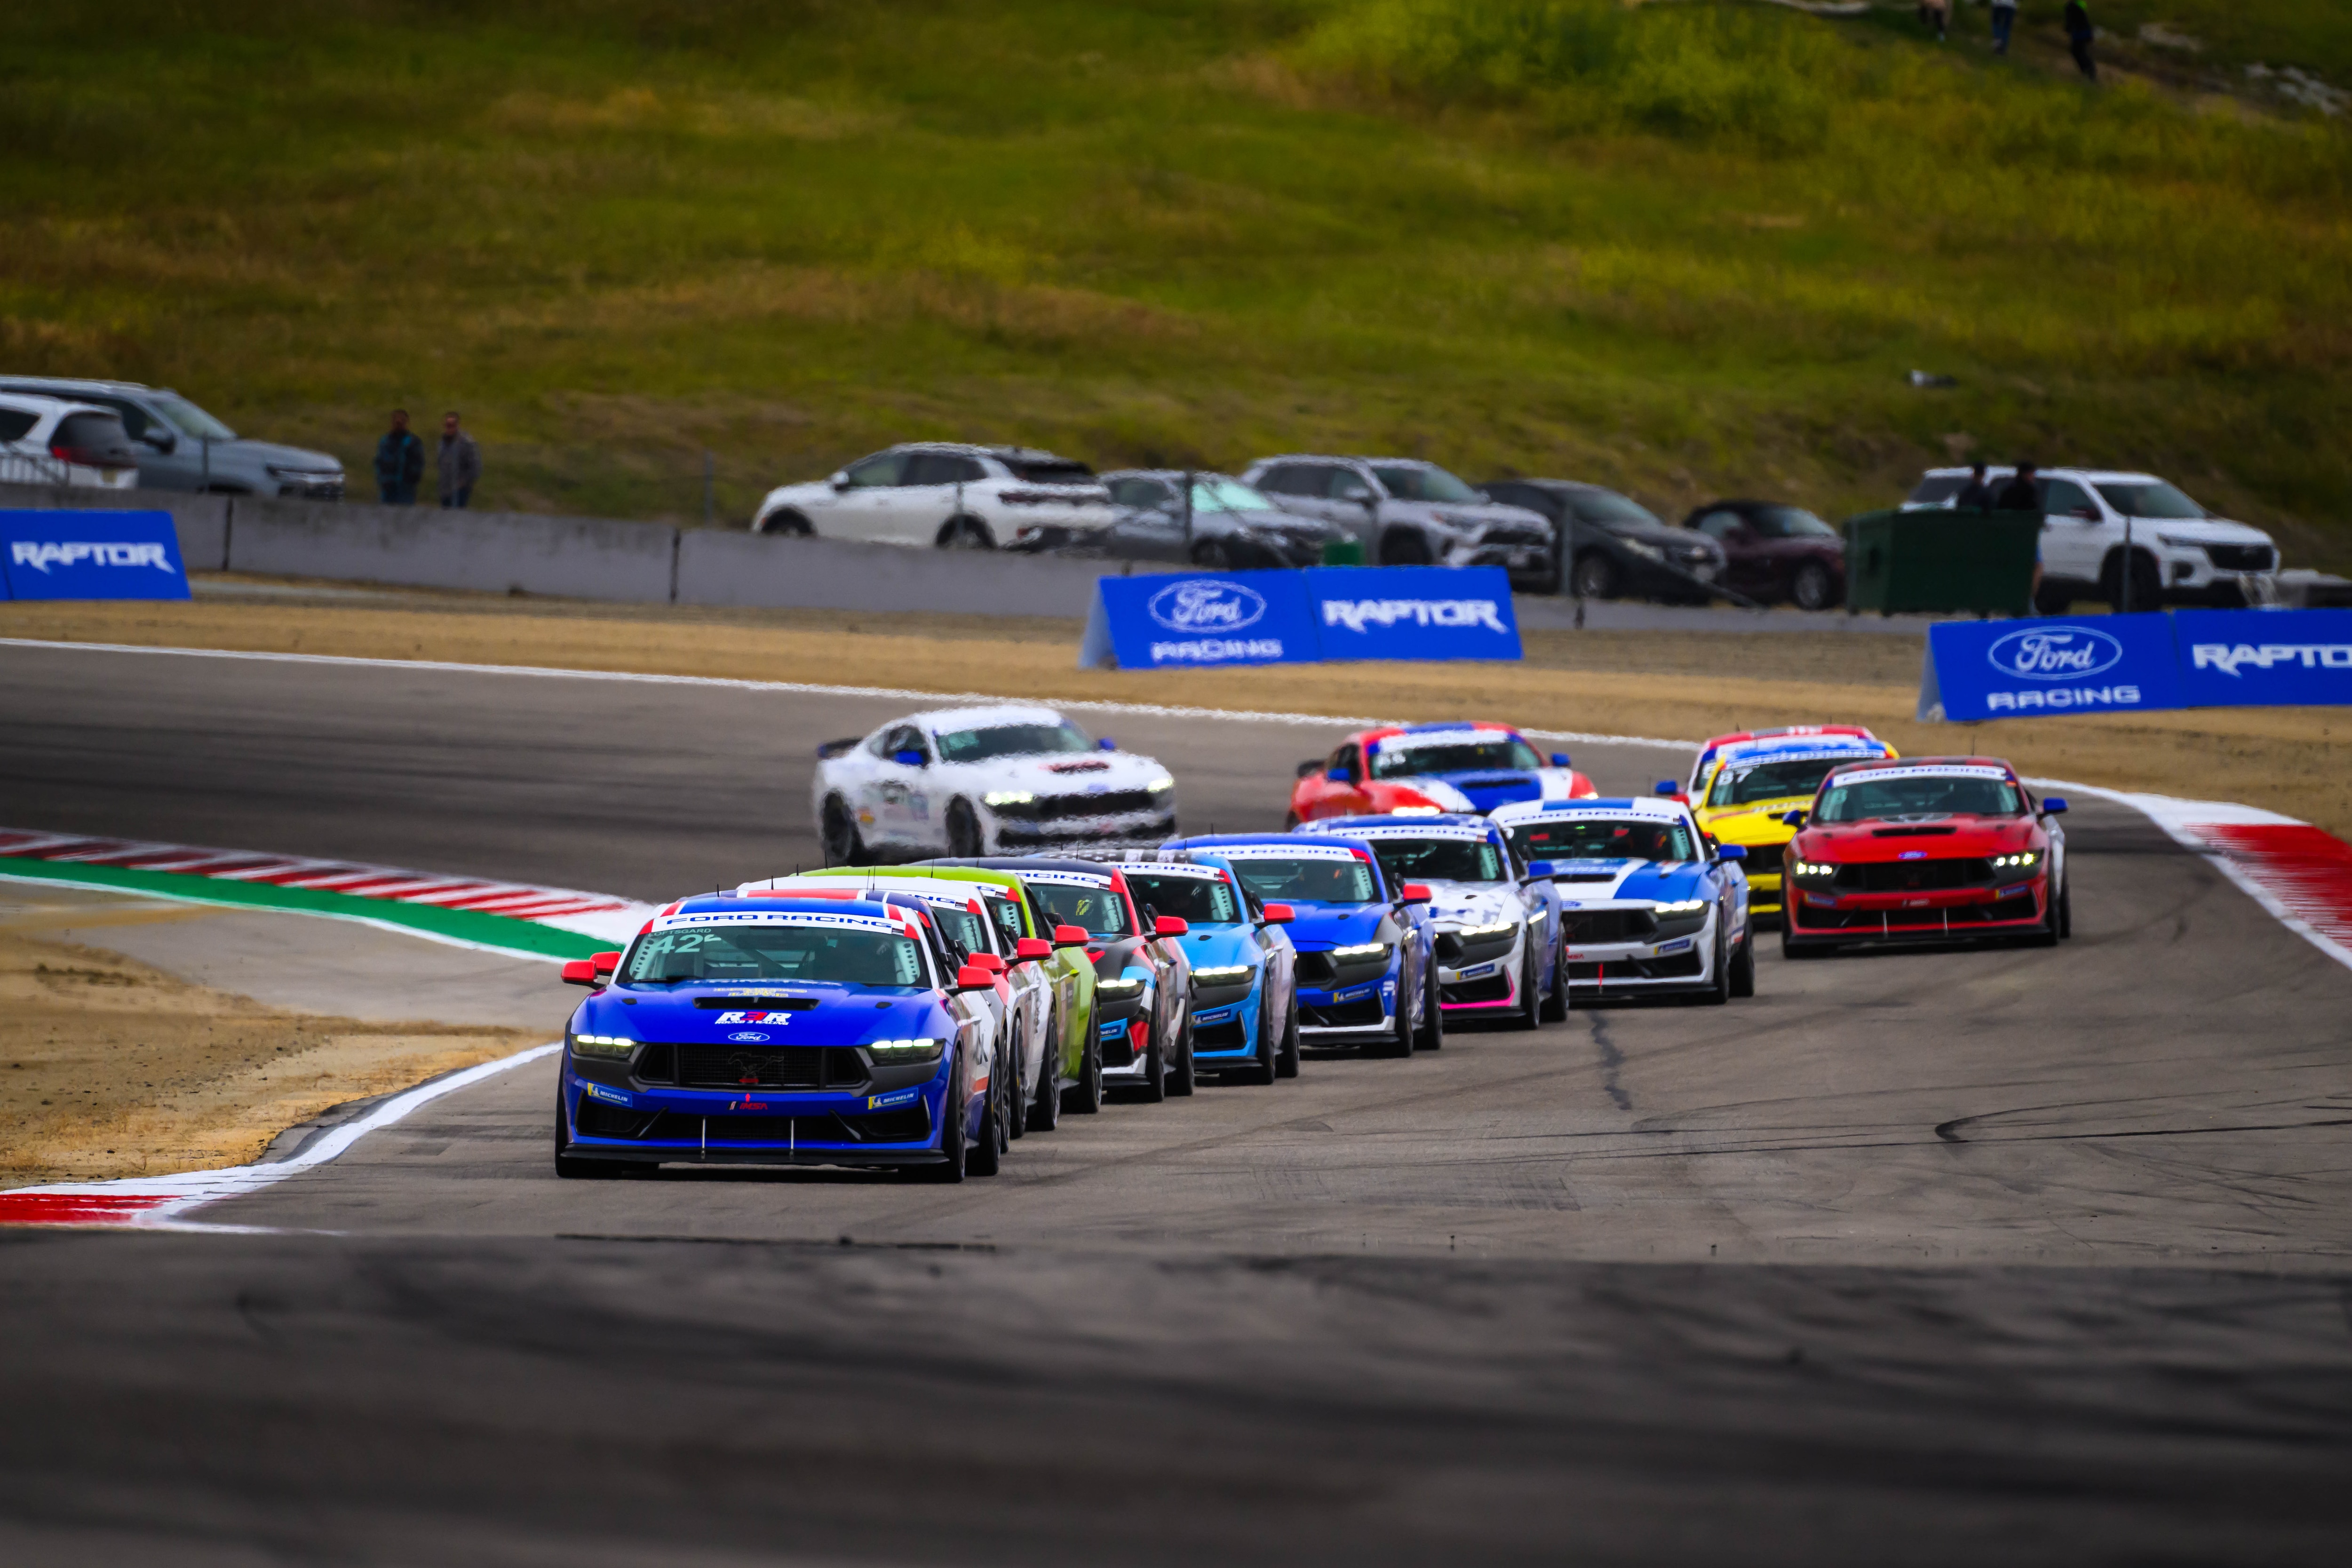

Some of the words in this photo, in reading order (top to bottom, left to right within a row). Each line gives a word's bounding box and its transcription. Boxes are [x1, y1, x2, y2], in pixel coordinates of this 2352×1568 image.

[11, 541, 176, 574] RAPTOR
[1172, 588, 1242, 623] Ford
[1321, 599, 1508, 634] RAPTOR
[1151, 639, 1283, 661] RACING
[2015, 634, 2096, 672] Ford
[2192, 644, 2352, 678] RAPTO
[1986, 685, 2141, 710] RACING
[1015, 873, 1099, 883] ACING
[667, 915, 758, 925] FORD
[767, 914, 892, 929] RACING
[652, 934, 704, 954] 42
[716, 1011, 792, 1022] R3R
[600, 1090, 628, 1102] MICHELIN
[883, 1093, 914, 1104] MICHELIN
